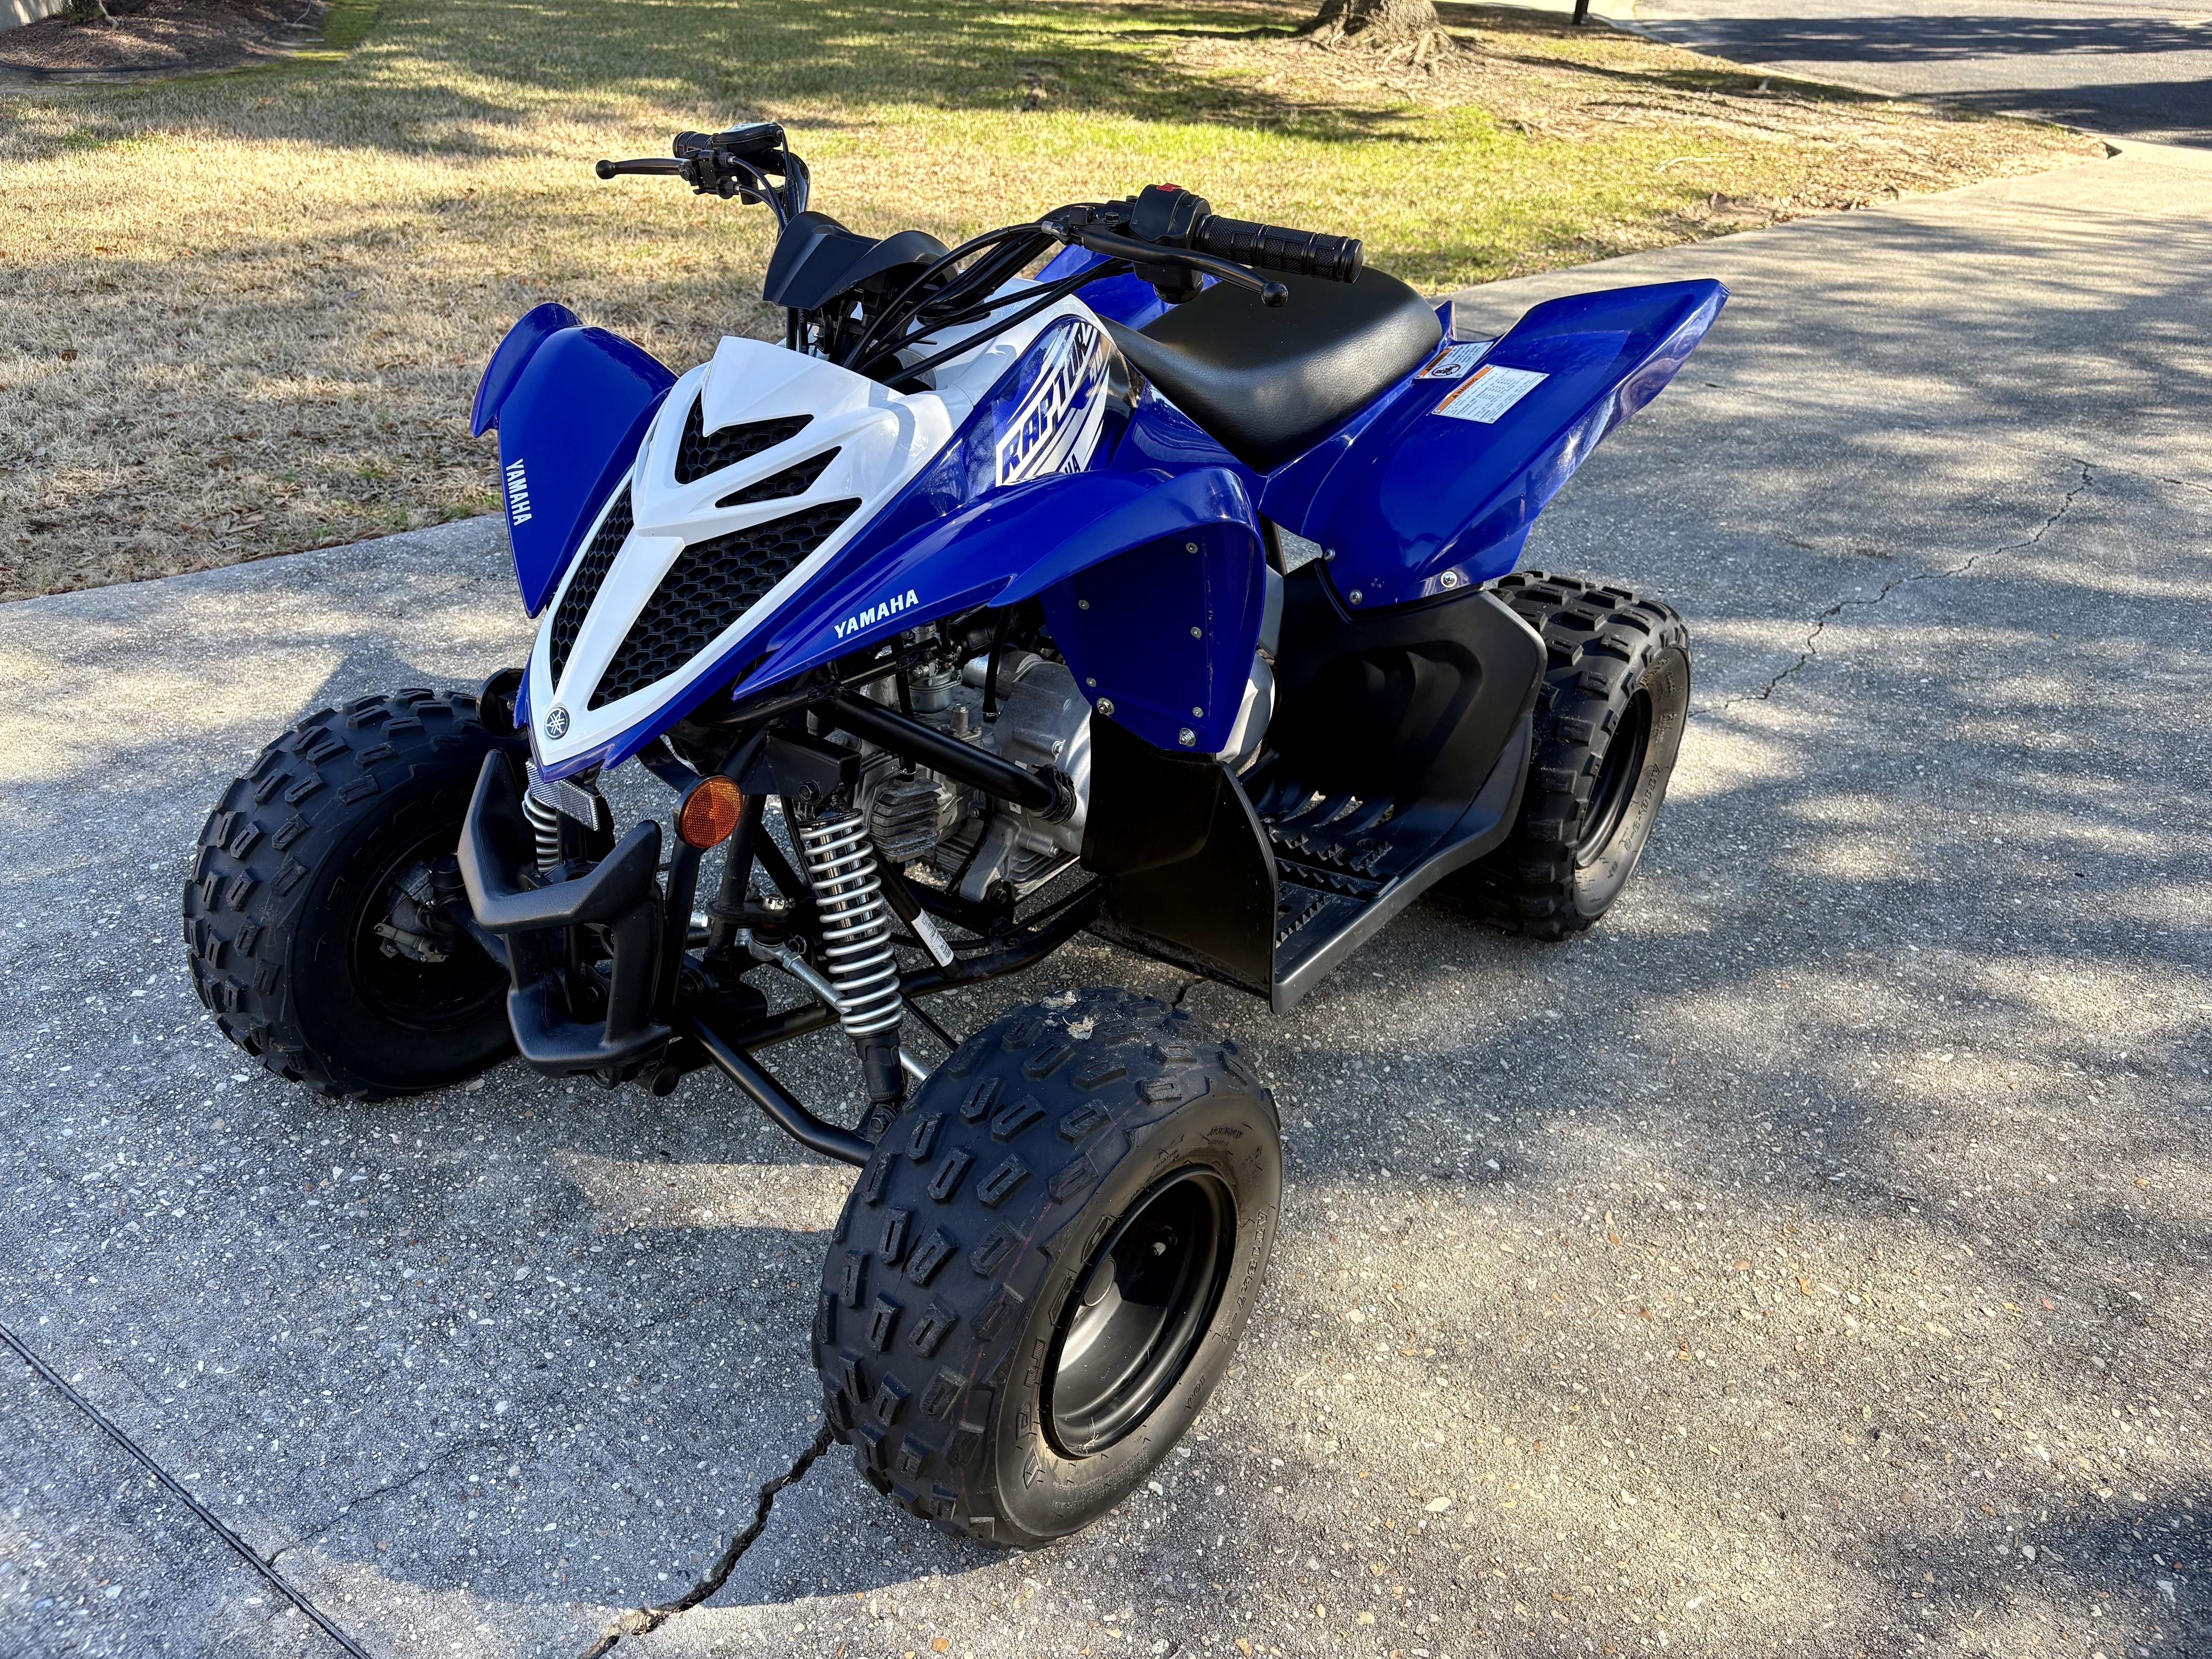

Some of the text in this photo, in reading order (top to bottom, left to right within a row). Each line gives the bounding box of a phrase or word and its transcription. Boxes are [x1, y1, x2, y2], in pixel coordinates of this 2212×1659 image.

[1002, 323, 1094, 484] RAPTOR
[1456, 378, 1477, 394] WARNING
[506, 458, 532, 526] YAMAHA
[834, 589, 919, 639] YAMAHA
